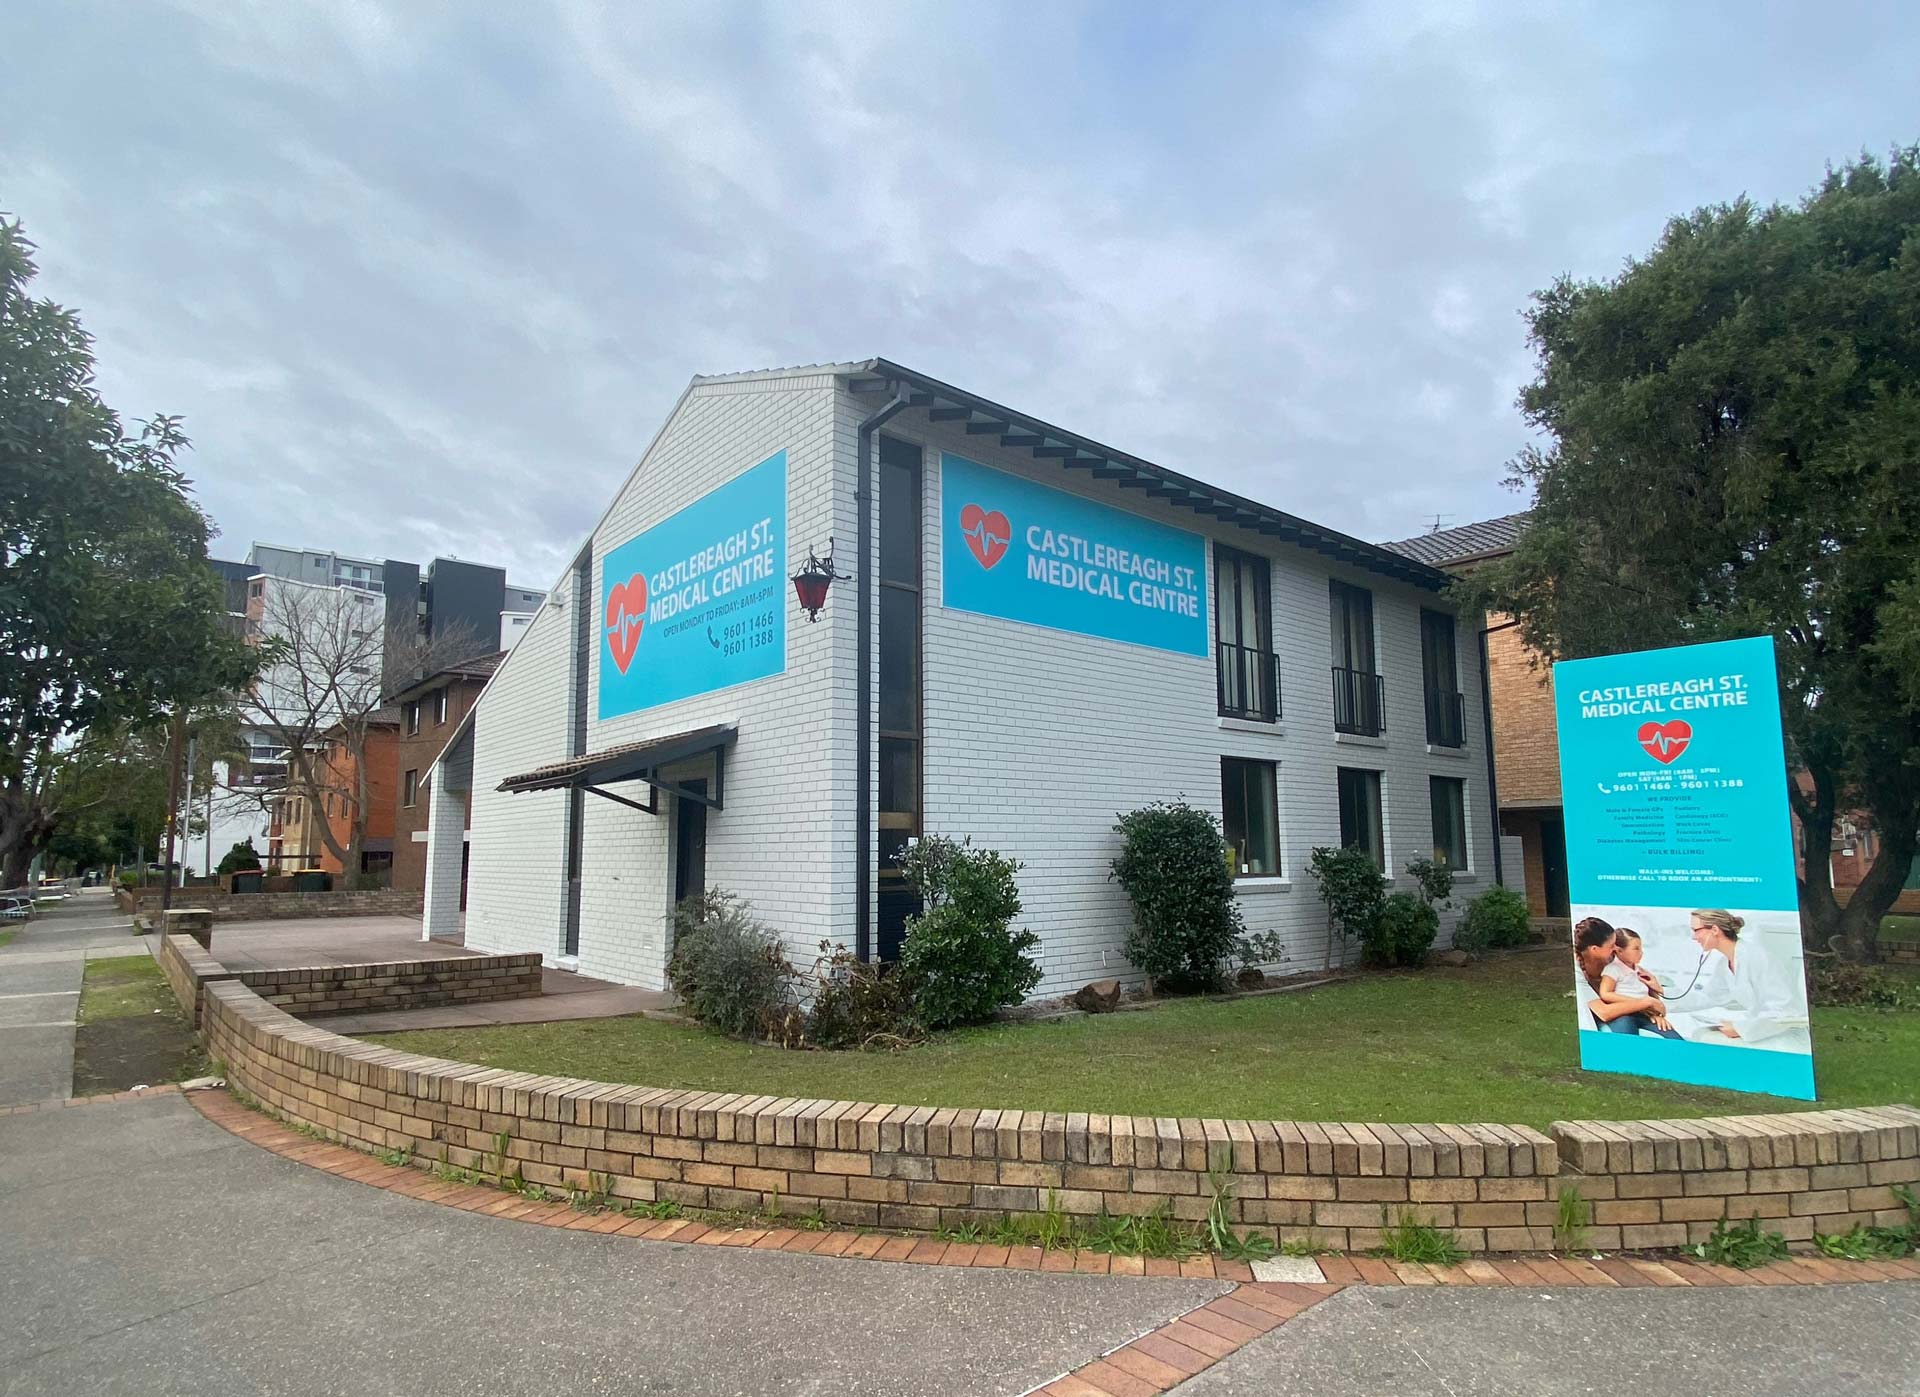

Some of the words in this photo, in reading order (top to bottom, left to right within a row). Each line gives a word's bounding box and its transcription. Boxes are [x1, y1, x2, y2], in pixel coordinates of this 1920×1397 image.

[651, 530, 747, 597] CASTLEREAGH
[751, 518, 774, 551] ST.
[1026, 525, 1169, 586] CASTLEREAGH
[1174, 566, 1198, 591] ST.
[650, 579, 710, 625] MEDICAL
[712, 549, 774, 598] CENTRE
[1027, 554, 1125, 601] MEDICAL
[1128, 581, 1199, 618] CENTRE
[663, 625, 679, 638] OPEN
[679, 615, 705, 632] MONDAY
[706, 610, 715, 622] TO
[723, 620, 746, 641] 9601
[750, 611, 774, 631] 1466
[723, 639, 746, 657] 9601
[750, 630, 774, 649] 1388
[1579, 677, 1714, 704] CASTLEREAGH
[1719, 674, 1748, 691] ST.
[1582, 699, 1667, 719] MEDICAL
[1670, 691, 1748, 711] CENTRE
[1613, 784, 1639, 792] 9601
[1644, 782, 1671, 790] 1466
[1681, 781, 1709, 789] 9601
[1715, 779, 1744, 788] 1388
[1639, 769, 1672, 777] MON-FRI
